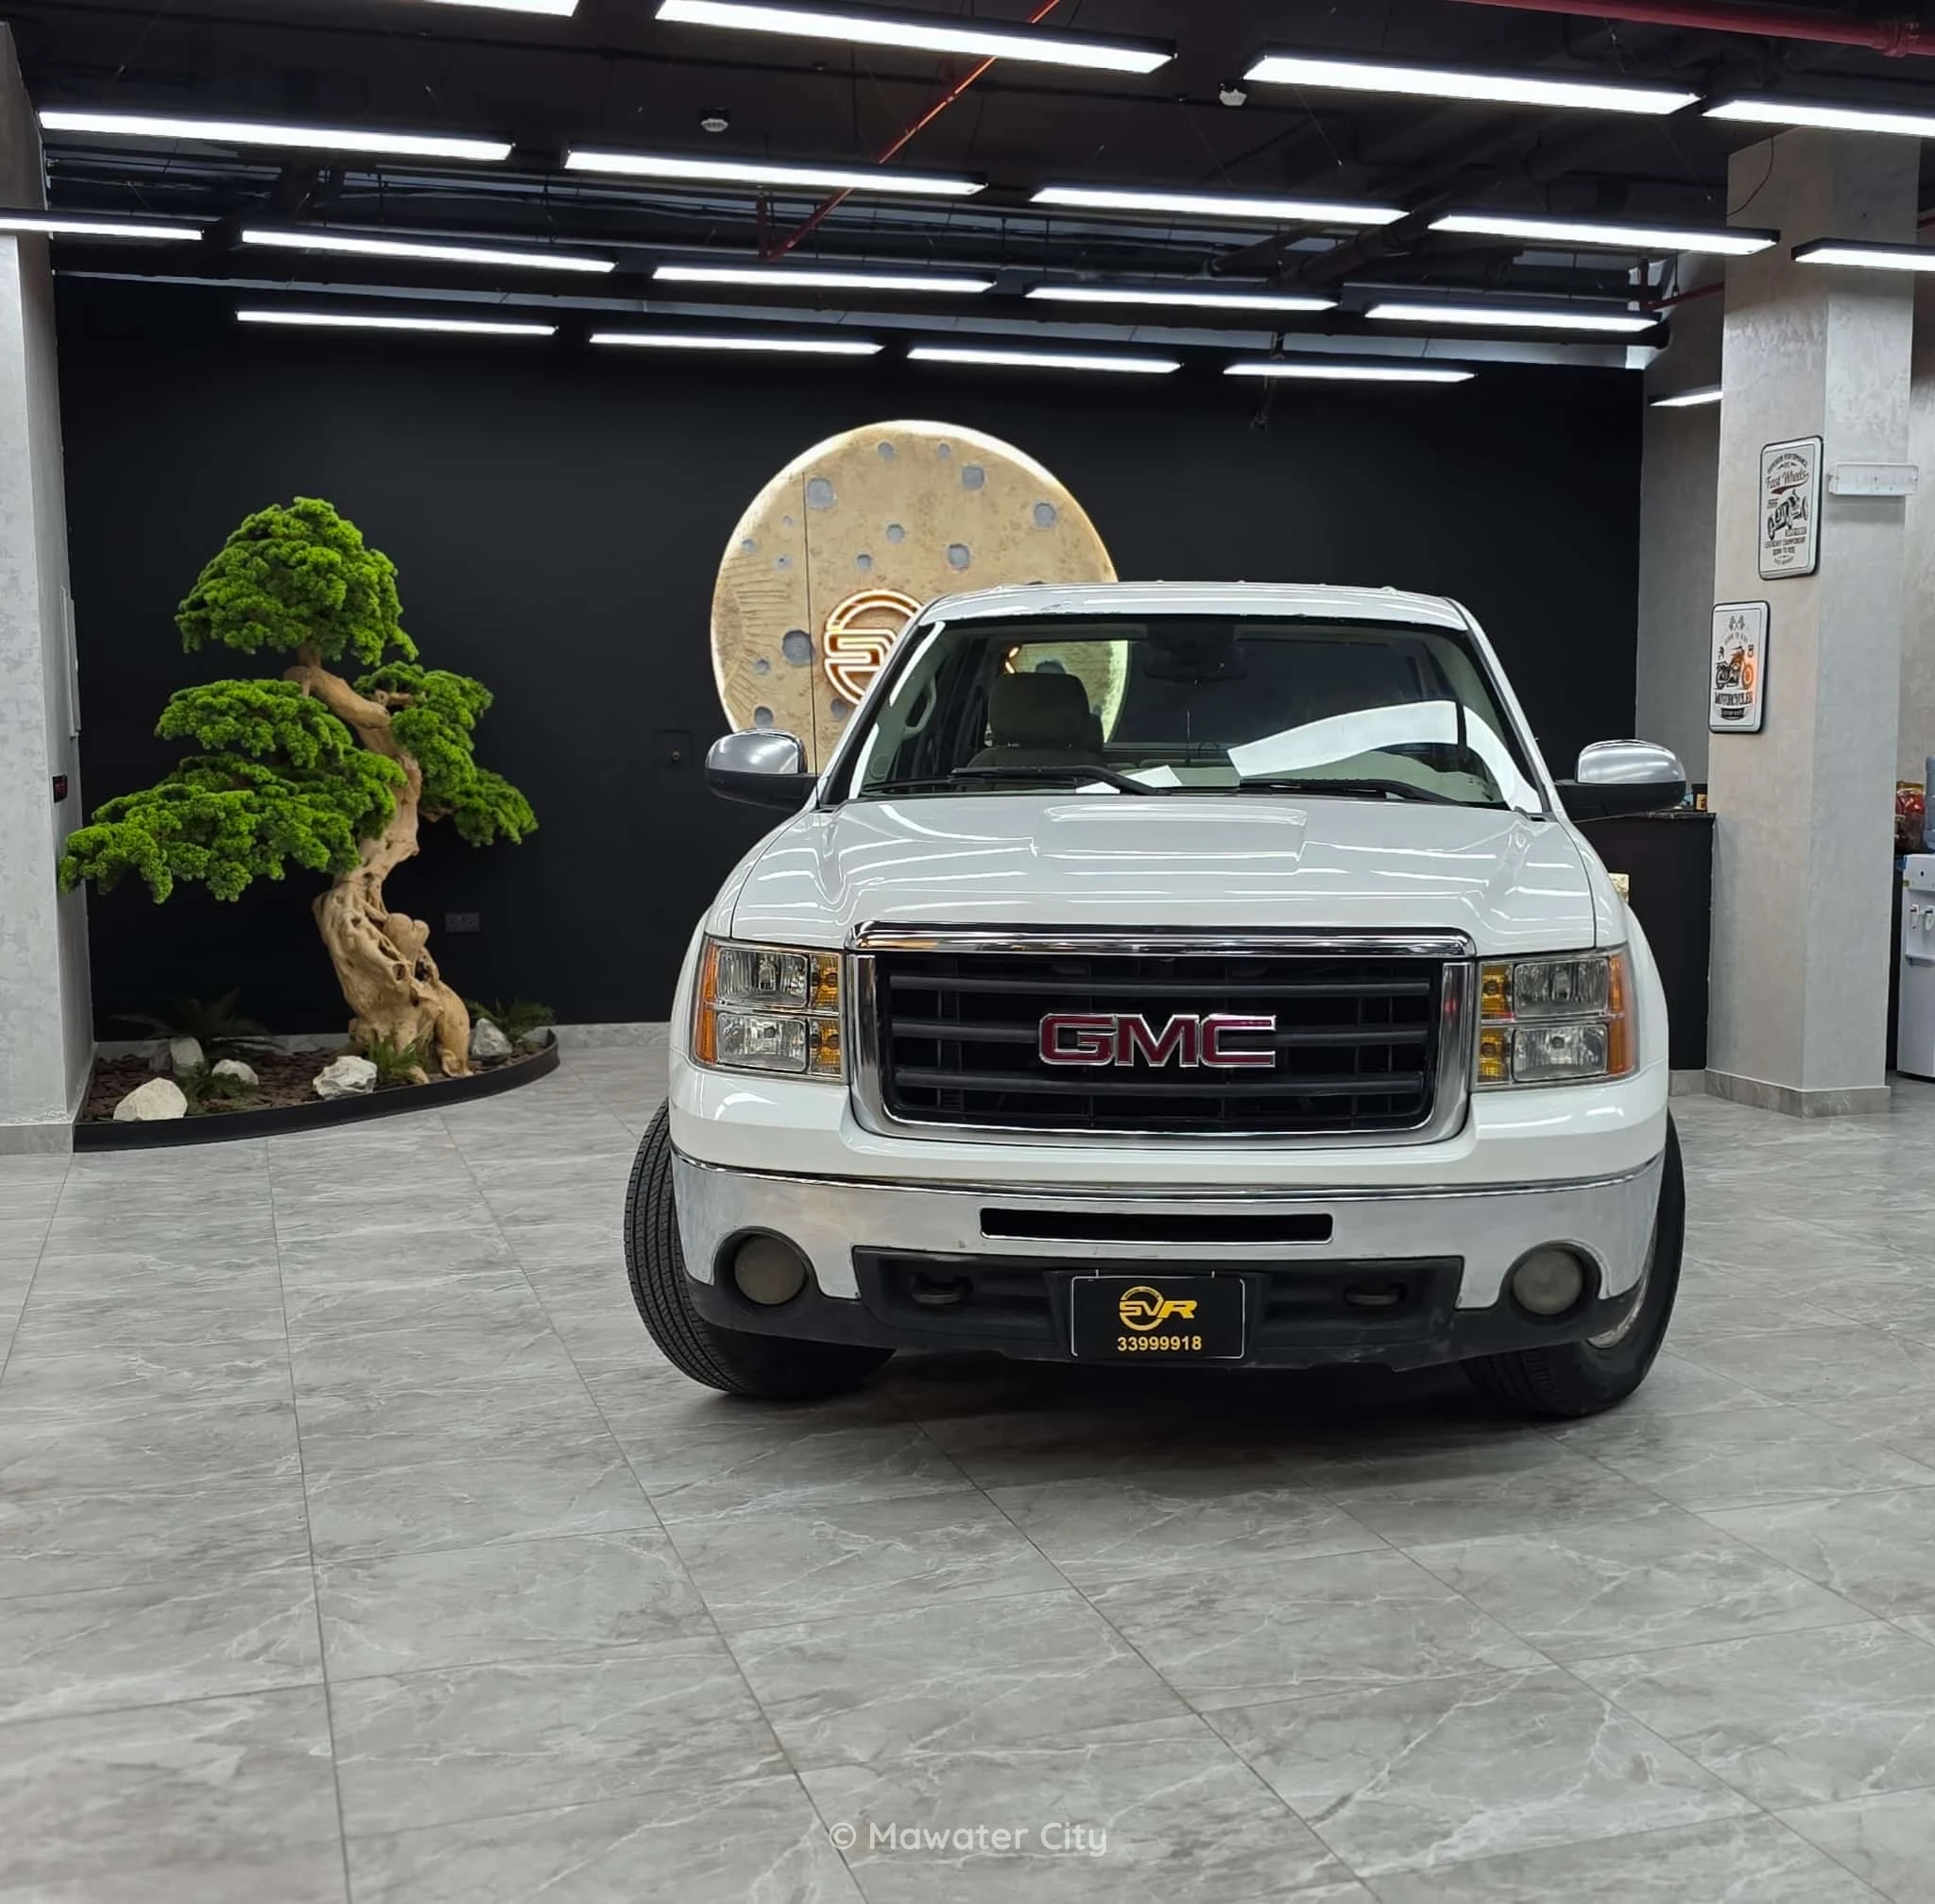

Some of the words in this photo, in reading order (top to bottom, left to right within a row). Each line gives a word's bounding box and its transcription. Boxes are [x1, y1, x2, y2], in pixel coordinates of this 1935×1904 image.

[1767, 475, 1781, 489] Fast
[1782, 470, 1808, 484] Wheels
[1039, 1013, 1276, 1068] GMC
[1118, 1336, 1202, 1351] 33999918
